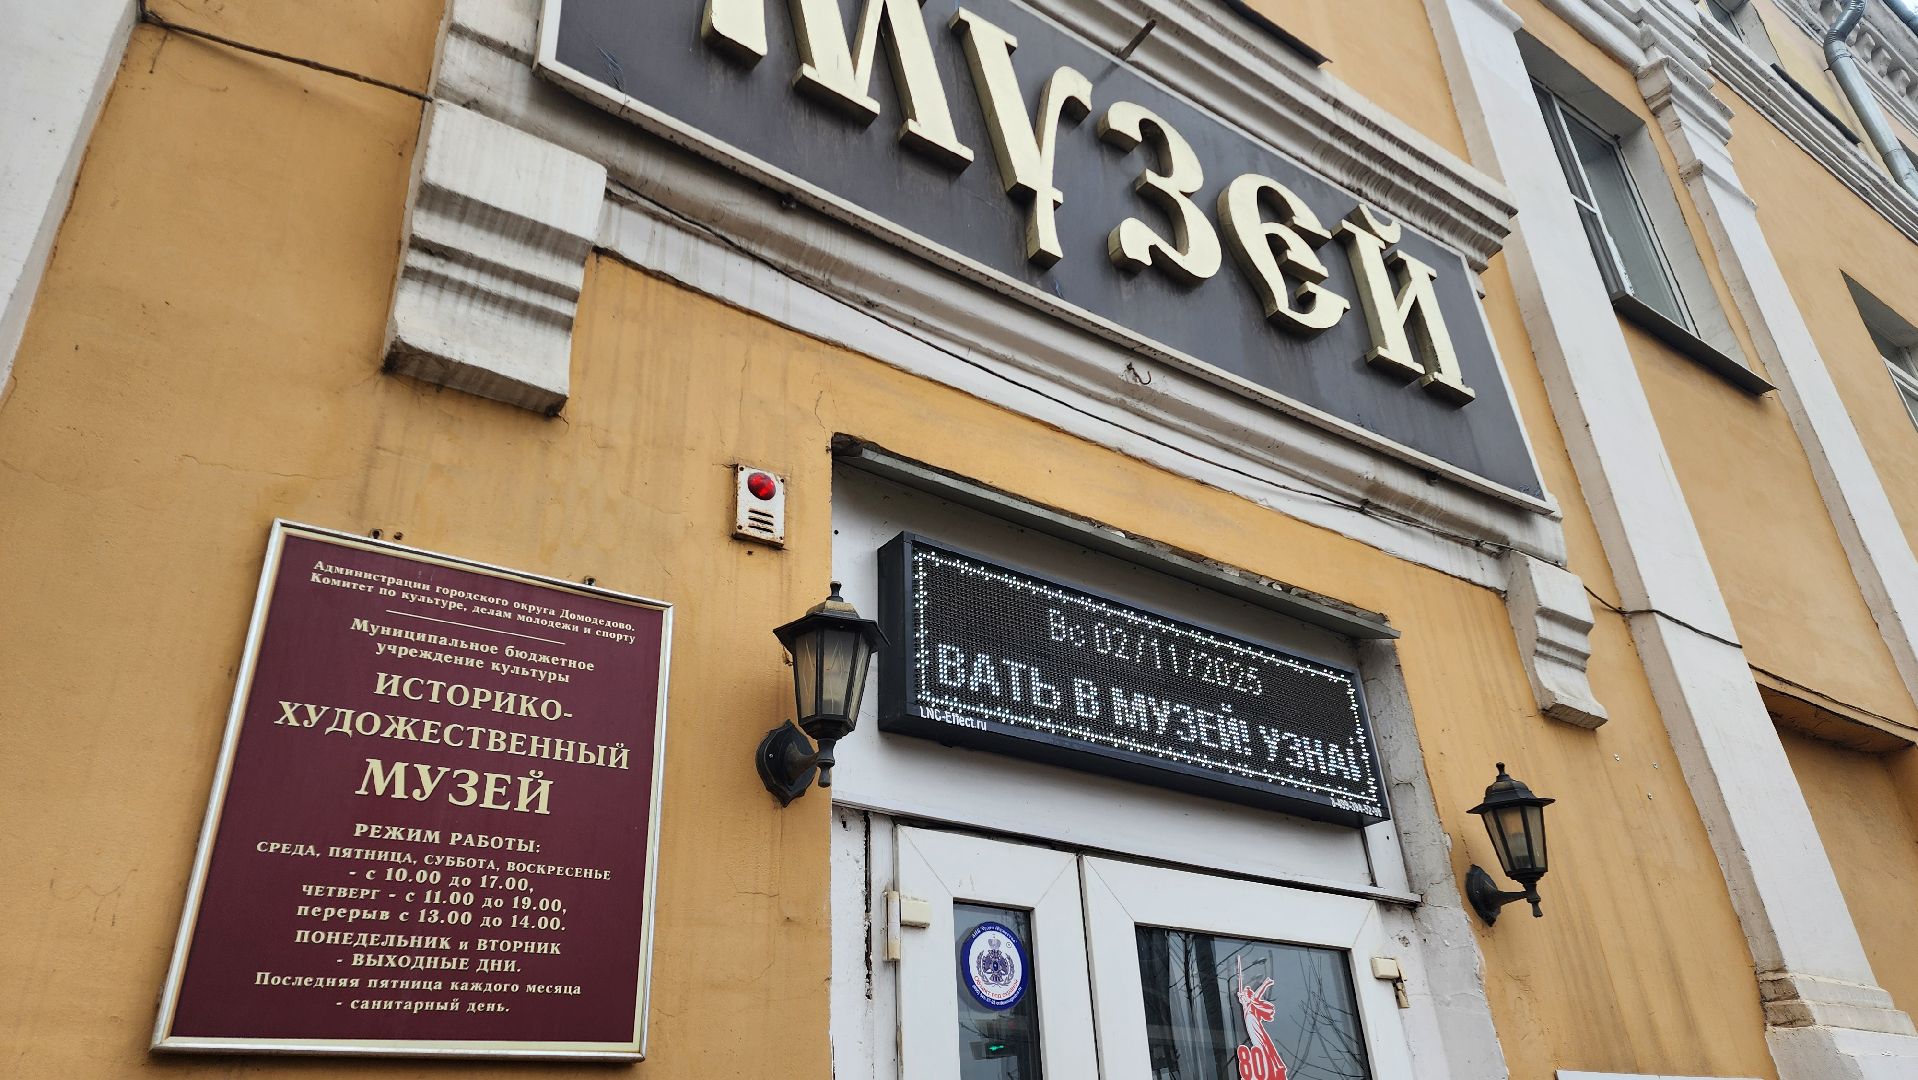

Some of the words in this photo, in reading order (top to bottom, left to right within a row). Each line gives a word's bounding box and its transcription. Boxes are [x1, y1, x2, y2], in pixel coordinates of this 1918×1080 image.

[310, 572, 374, 592] Комитет
[379, 587, 396, 596] по
[402, 592, 467, 611] культуре,
[472, 606, 512, 619] делам
[517, 614, 578, 632] молодежи
[596, 630, 635, 644] спорту
[314, 561, 430, 590] Администрации
[436, 586, 509, 606] городского
[514, 602, 555, 615] округа
[560, 609, 634, 631] Домодедово.
[350, 618, 498, 654] Муниципальное
[505, 646, 594, 671] бюджетное
[1049, 608, 1086, 647] Вс
[1094, 622, 1263, 696] 02/11/2025
[376, 643, 484, 668] учреждение
[491, 662, 569, 683] культуры
[374, 673, 572, 720] ИСТОРИКО-
[938, 642, 1062, 710] ВАТЬ
[1073, 678, 1100, 719] В
[1111, 685, 1252, 756] МУЗЕЙ!
[274, 701, 630, 769] ХУДОЖЕСТВЕННЫЙ
[919, 705, 988, 731] LNC-Effect.ru
[355, 759, 553, 814] МУЗЕЙ
[354, 824, 440, 843] РЕЖИМ
[449, 833, 540, 853] РАБОТЫ:
[257, 842, 320, 857] СРЕДА,
[329, 847, 417, 865] ПЯТНИЦА,
[424, 855, 499, 871] СУББОТА,
[507, 862, 610, 880] ВОСКРЕСЕНЬЕ
[366, 870, 376, 880] с
[385, 868, 441, 884] 10.00
[449, 877, 471, 887] до
[480, 875, 533, 893] 17.00,
[297, 906, 390, 922] перерыв
[399, 912, 409, 921] с
[419, 909, 472, 925] 13.00
[480, 917, 502, 928] до
[511, 915, 565, 930] 14.00.
[303, 885, 380, 899] ЧЕТВЕРГ
[406, 892, 415, 902] с
[424, 890, 474, 905] 11.00
[482, 898, 503, 908] до
[513, 896, 566, 915] 19.00,
[295, 930, 451, 949] ПОНЕДЕЛЬНИК
[459, 941, 468, 950] и
[477, 939, 560, 954] ВТОРНИК
[351, 954, 469, 970] ВЫХОДНЫЕ
[476, 959, 520, 973] ДНИ.
[255, 972, 359, 988] Последняя
[368, 979, 442, 991] пятница
[450, 982, 519, 993] каждого
[526, 985, 580, 995] месяца
[351, 998, 459, 1013] санитарный
[467, 1003, 509, 1013] день.
[1237, 1046, 1267, 1080] 80
